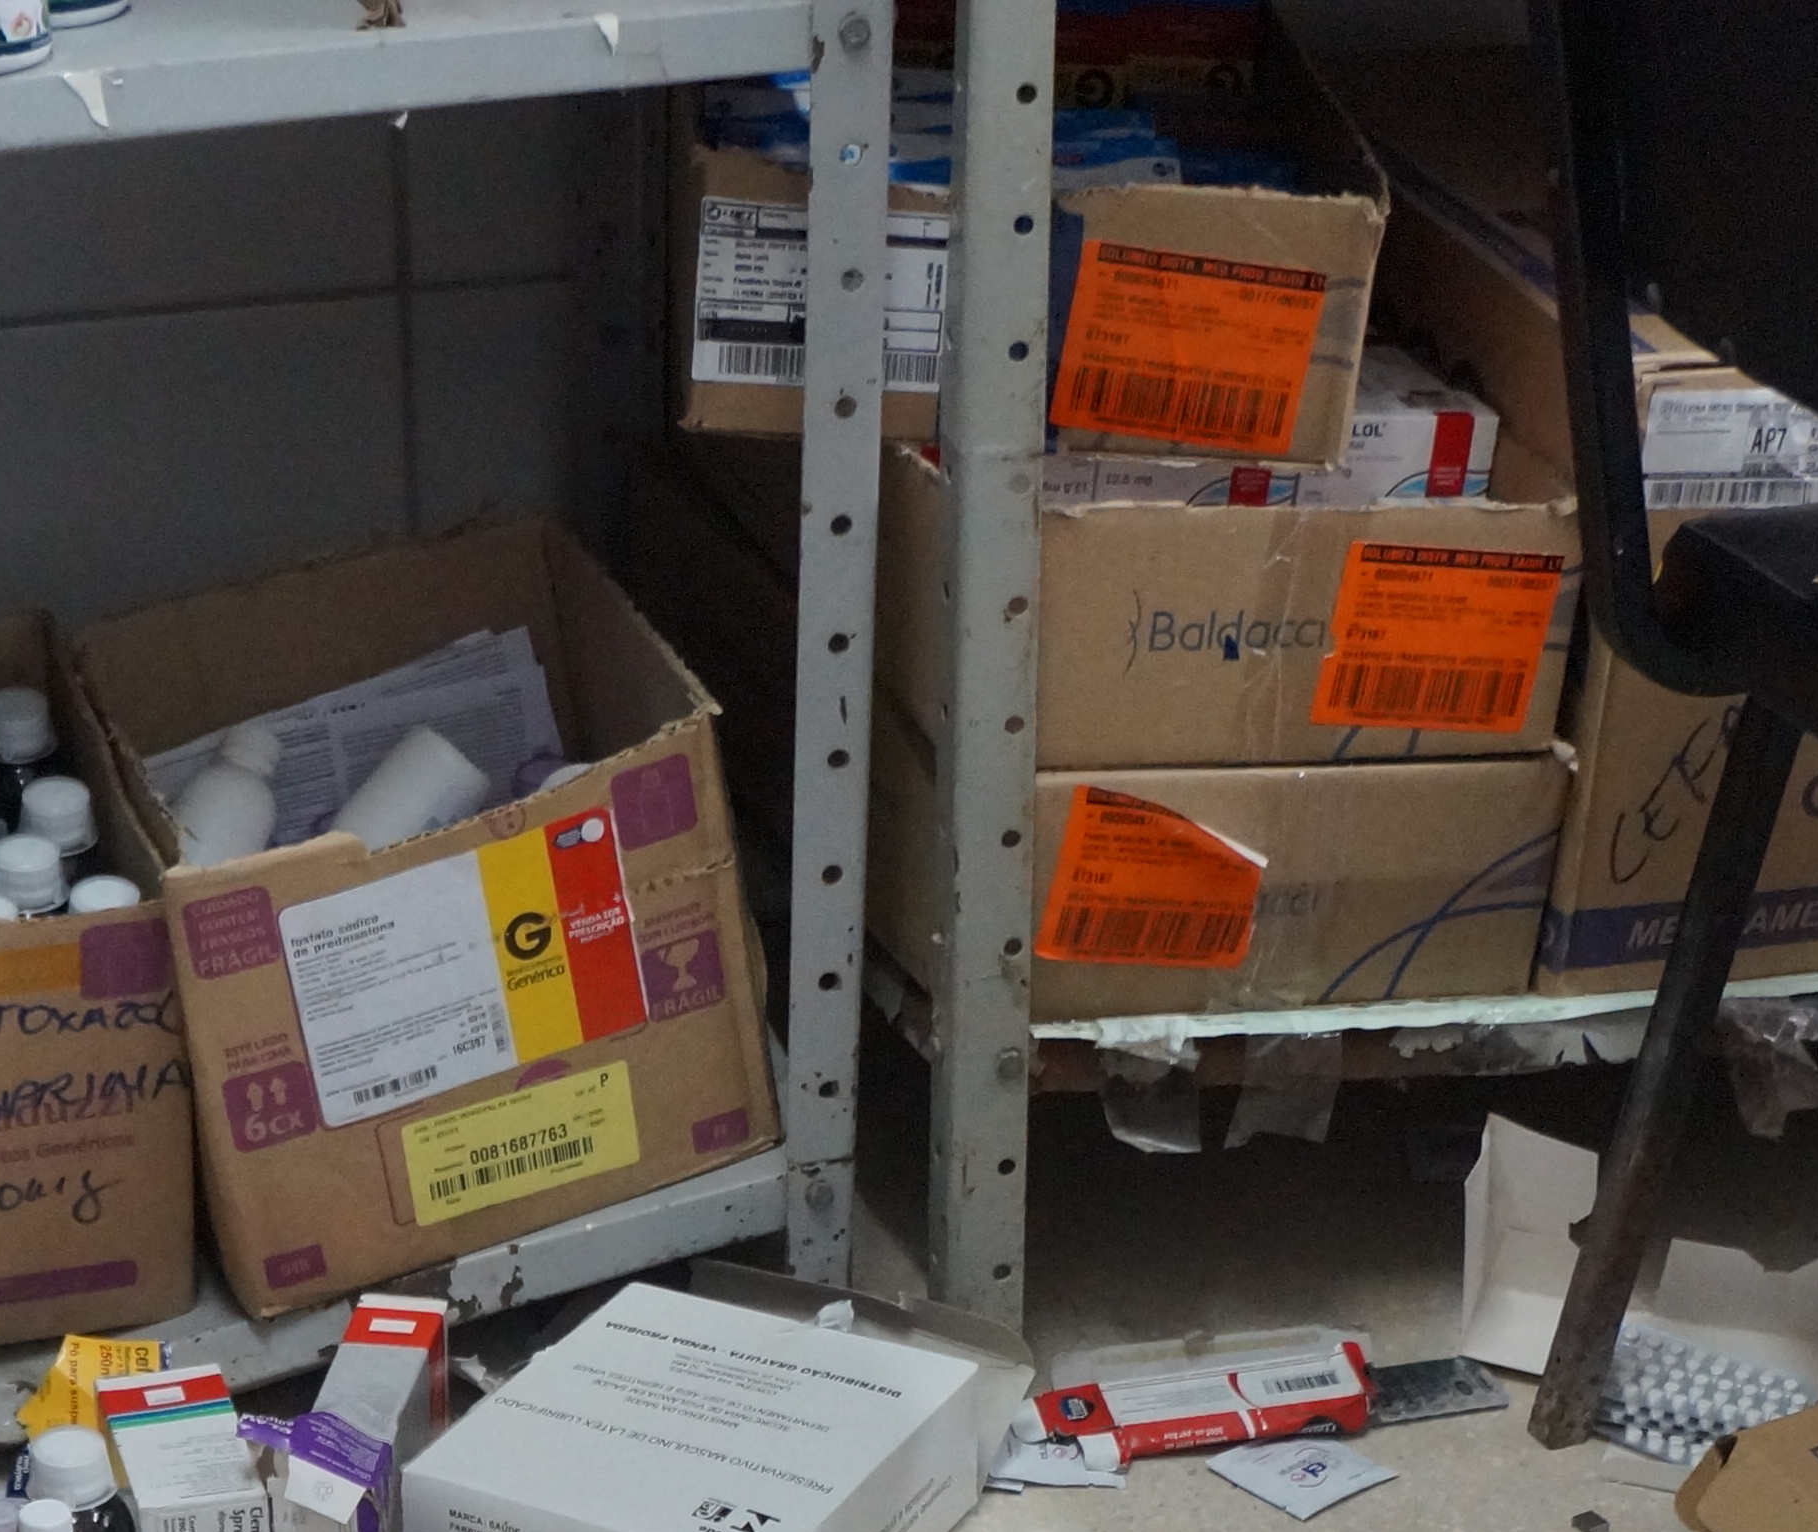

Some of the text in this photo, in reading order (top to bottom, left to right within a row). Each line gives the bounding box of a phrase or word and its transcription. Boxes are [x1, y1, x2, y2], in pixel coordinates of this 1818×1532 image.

[468, 1124, 569, 1166] 0081687763
[493, 1396, 582, 1431] LUBRIFICADO
[629, 1432, 647, 1445] DE
[648, 1437, 728, 1464] MASCULINO
[730, 1459, 834, 1495] PRESERVATIVO
